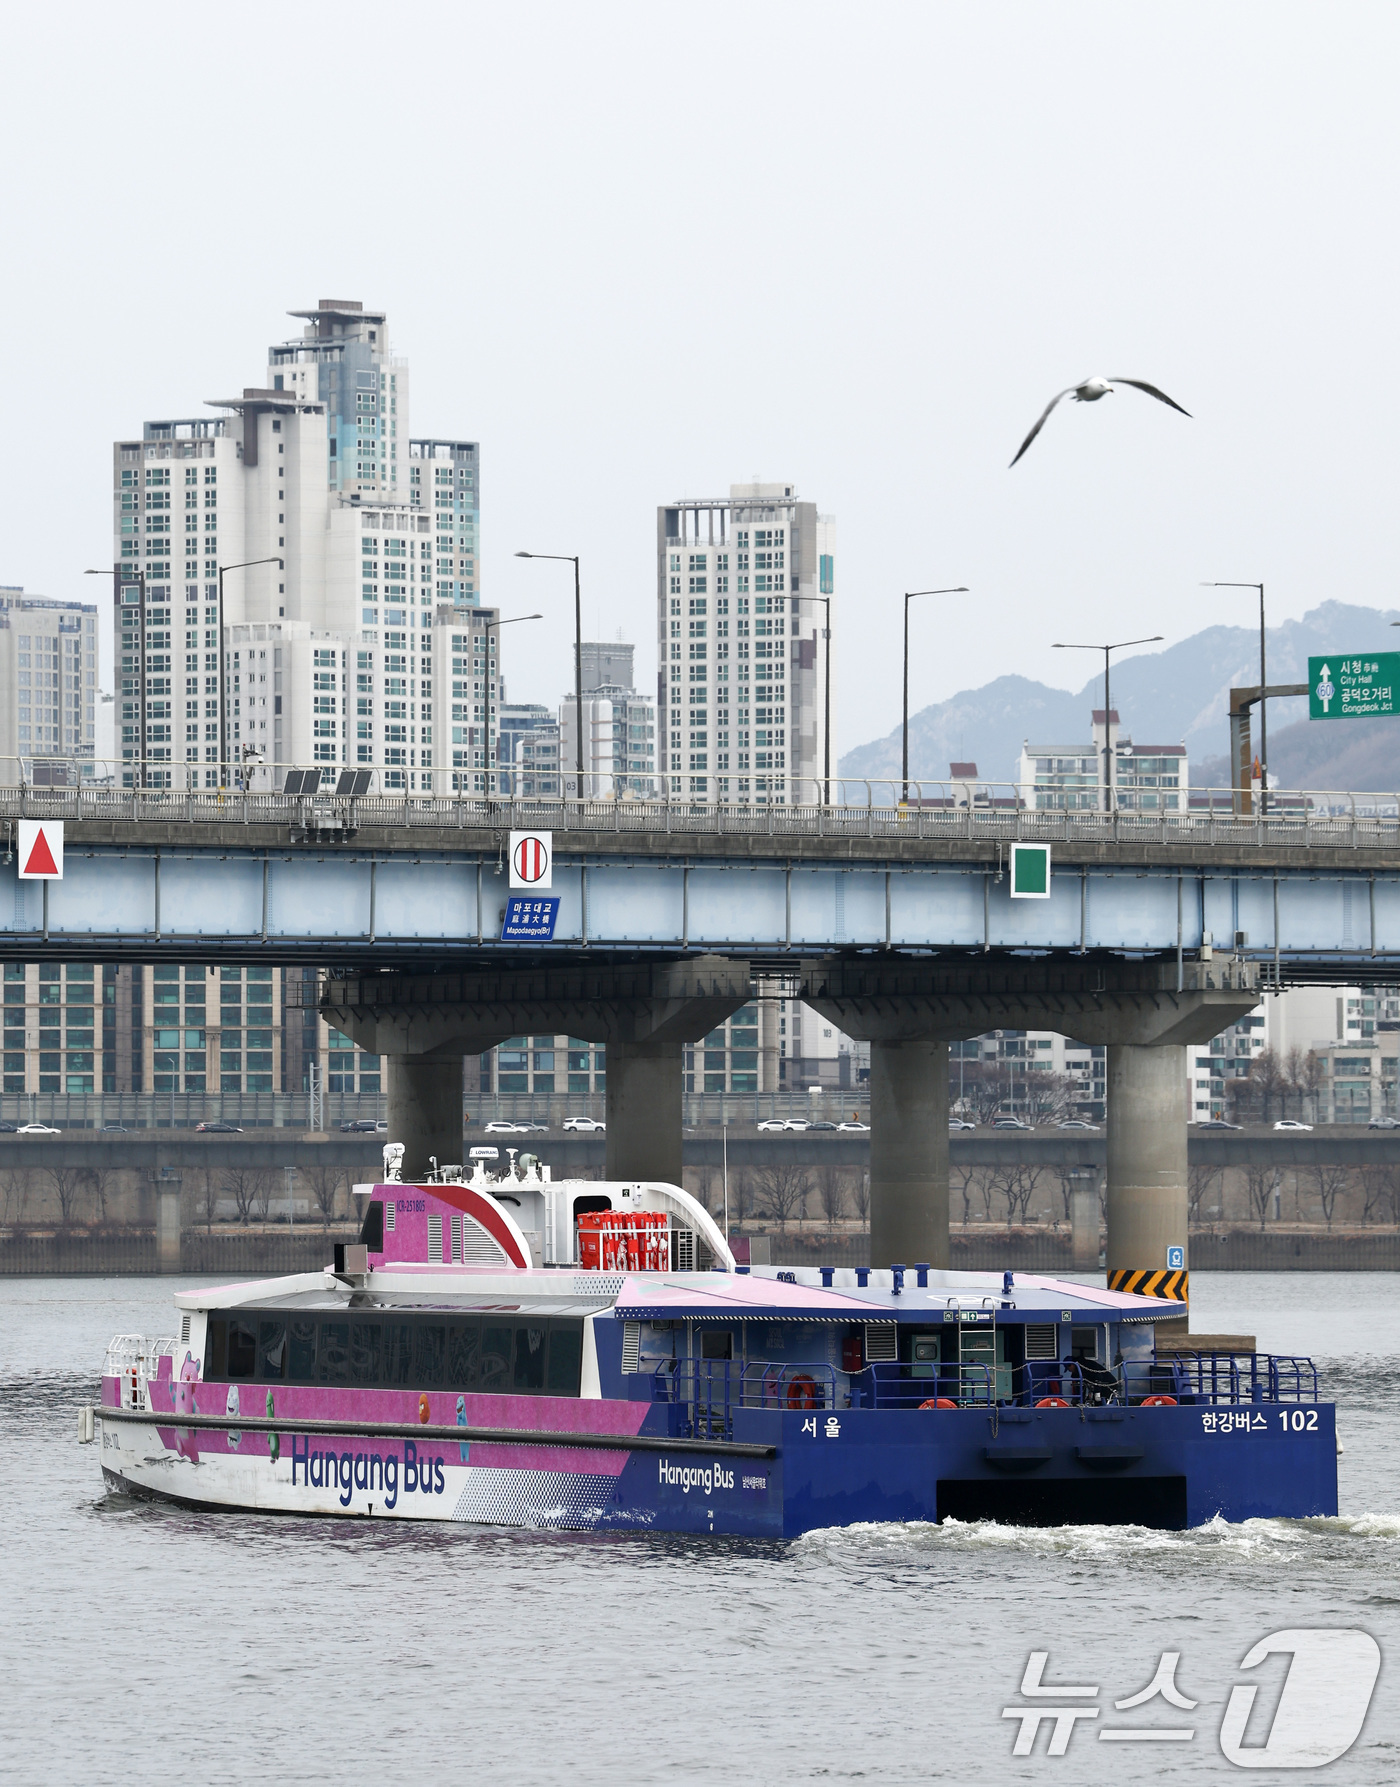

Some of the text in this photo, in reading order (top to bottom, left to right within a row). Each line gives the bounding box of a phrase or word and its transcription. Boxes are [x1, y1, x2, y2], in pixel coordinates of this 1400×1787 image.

[1340, 660, 1362, 674] 시청
[1340, 674, 1373, 686] City Hall
[1320, 684, 1331, 697] 60
[1341, 686, 1392, 702] 공덕오거리
[1342, 702, 1393, 714] Gongdeok Jct
[514, 903, 551, 912] 마포대교
[507, 927, 550, 935] Mapodaegyo(Br)
[801, 1416, 841, 1438] 서울
[1202, 1410, 1319, 1433] 한강버스 102
[292, 1435, 445, 1509] Hangang Bus
[659, 1459, 735, 1495] Hangang Bus
